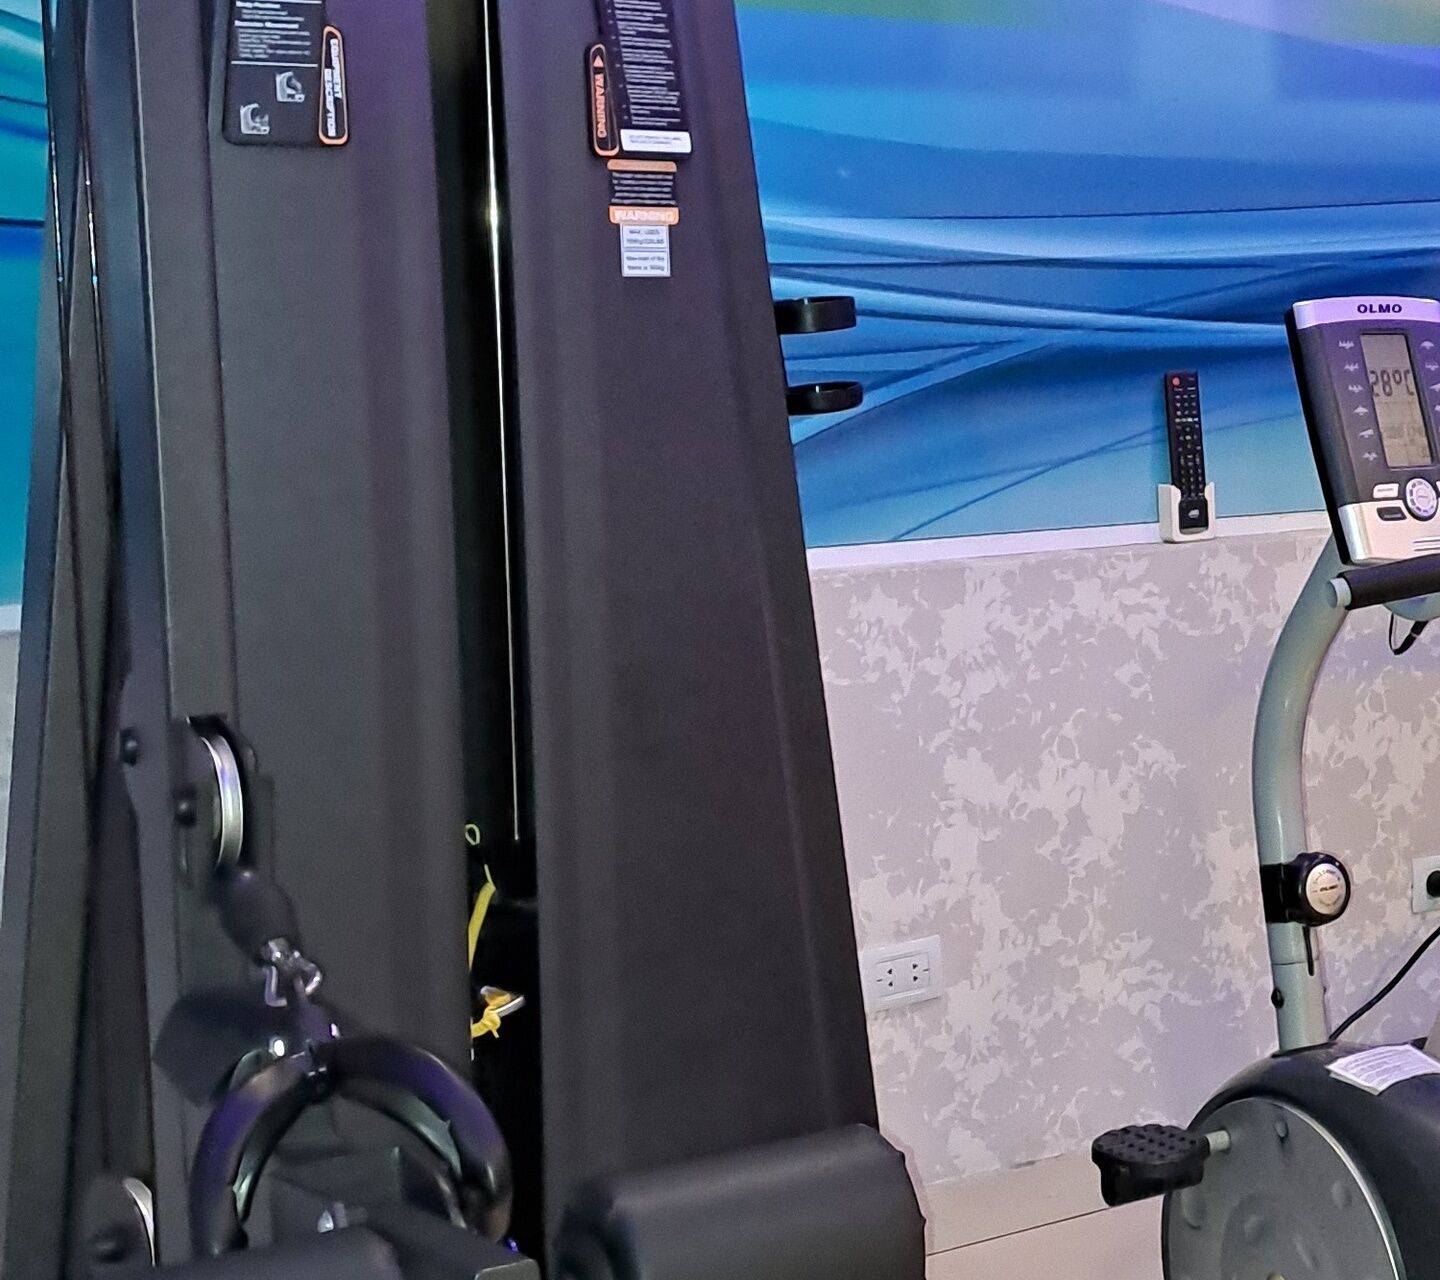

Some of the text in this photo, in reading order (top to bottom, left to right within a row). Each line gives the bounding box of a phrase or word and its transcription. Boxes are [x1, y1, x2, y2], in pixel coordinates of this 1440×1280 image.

[330, 38, 342, 99] EQUIPMENT
[324, 68, 336, 137] DESCRIPTION
[594, 73, 607, 138] WARNING
[1357, 303, 1402, 314] OLMO
